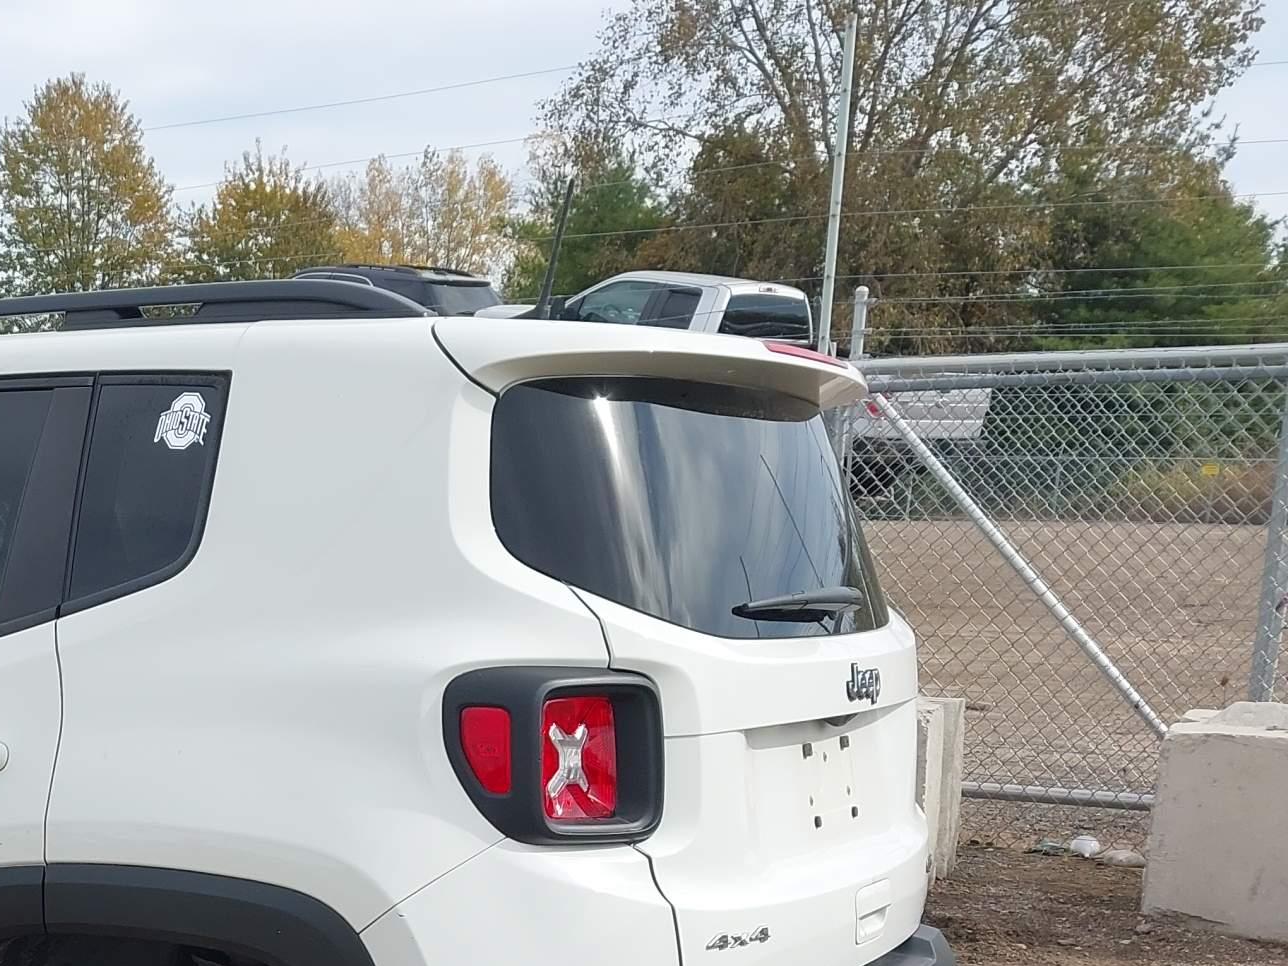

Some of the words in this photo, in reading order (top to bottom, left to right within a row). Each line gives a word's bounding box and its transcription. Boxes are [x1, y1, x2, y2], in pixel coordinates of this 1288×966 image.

[154, 410, 181, 443] OHIO
[178, 407, 211, 446] STATE
[846, 662, 881, 705] Jeep
[705, 924, 771, 951] 4x4
